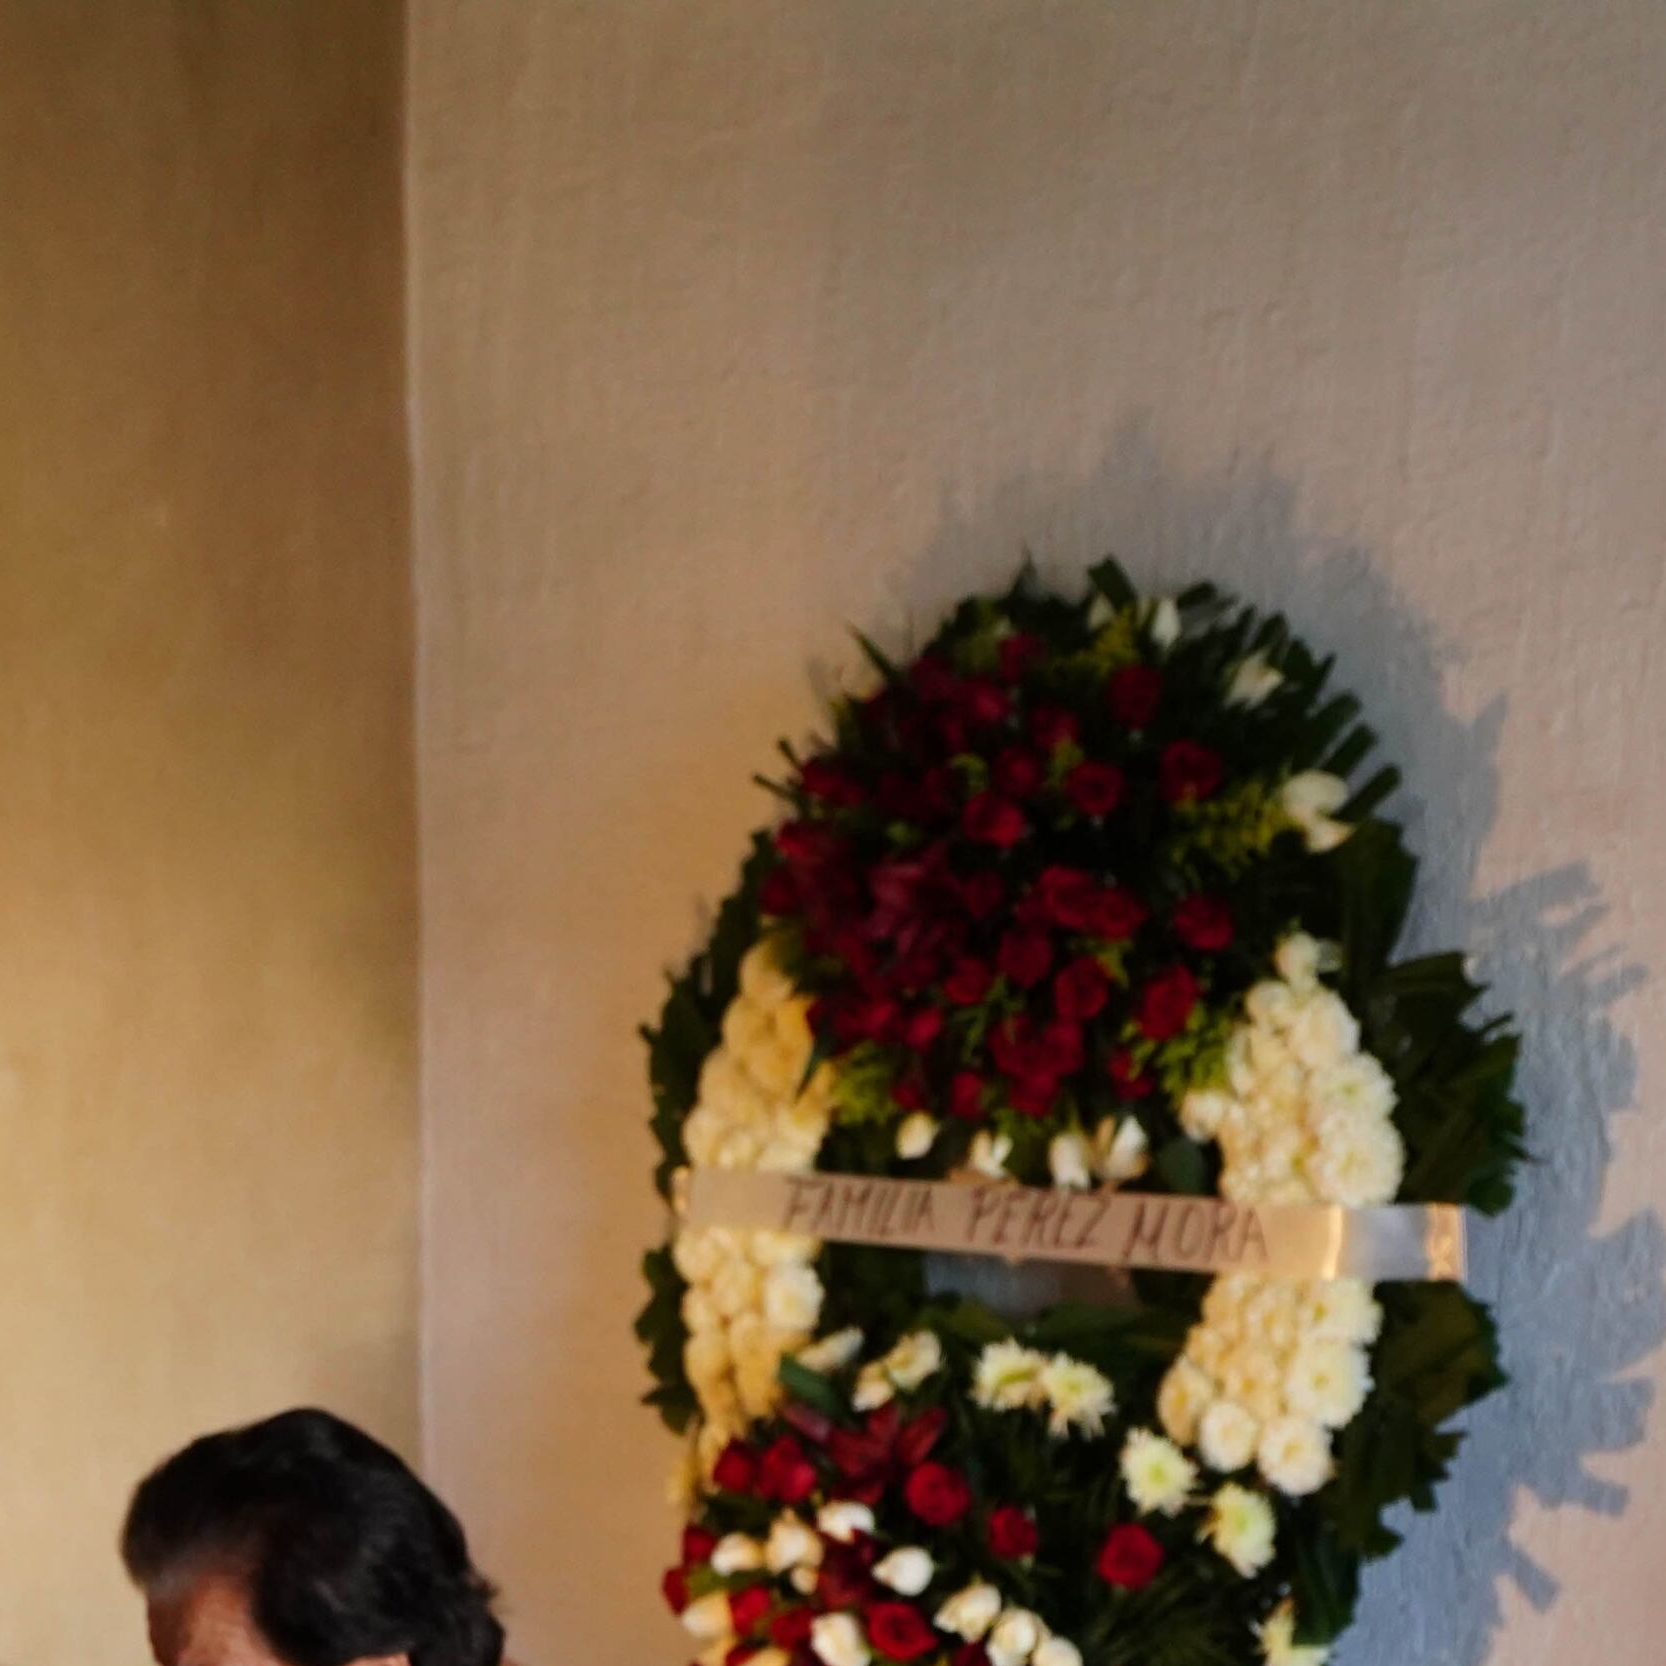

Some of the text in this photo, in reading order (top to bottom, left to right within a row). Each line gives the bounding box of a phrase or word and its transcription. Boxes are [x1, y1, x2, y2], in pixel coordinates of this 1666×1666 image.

[782, 1174, 1270, 1262] FAMILIA PEREZ MORA
